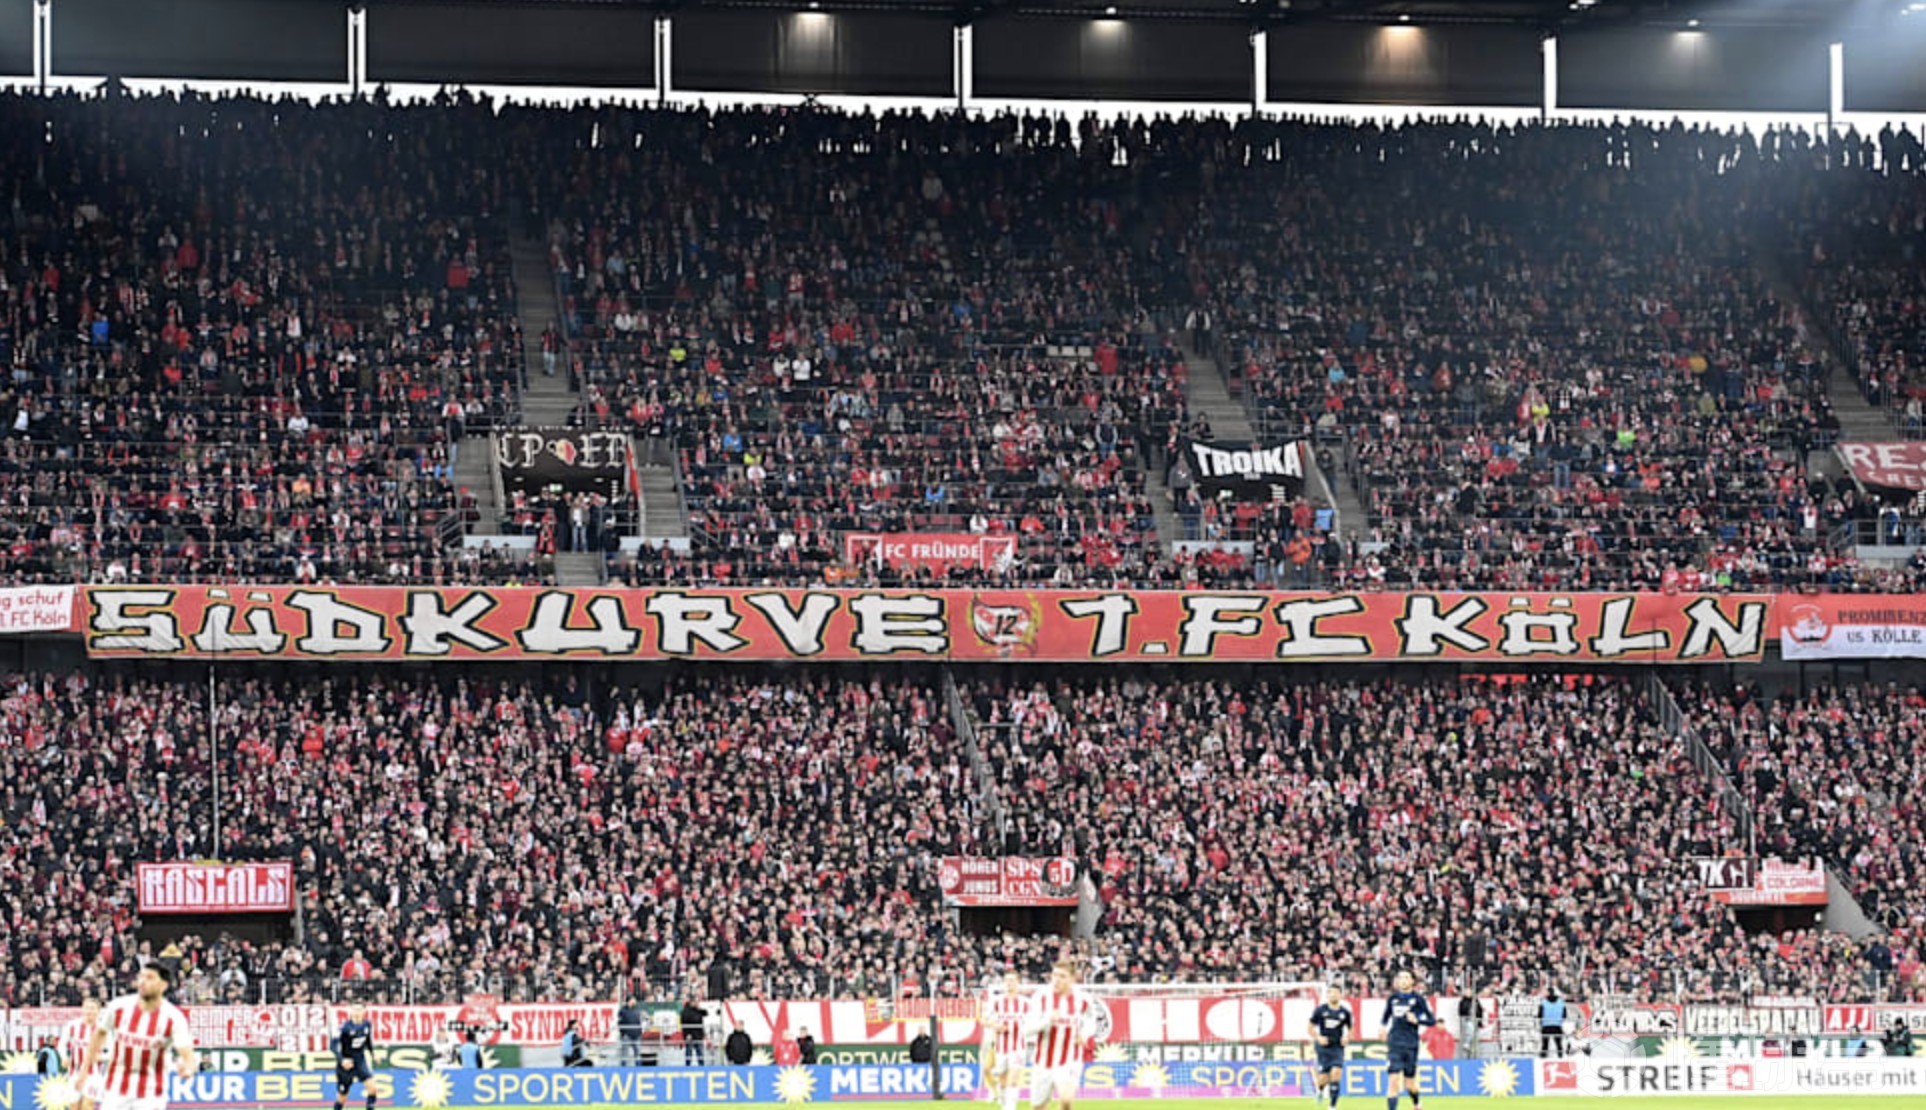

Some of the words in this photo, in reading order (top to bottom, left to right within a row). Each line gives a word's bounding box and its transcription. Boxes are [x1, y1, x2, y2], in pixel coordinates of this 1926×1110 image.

[1192, 441, 1303, 478] TROIKA
[885, 543, 907, 559] FC
[911, 541, 980, 560] FRÜNDE
[18, 590, 63, 606] schuf
[11, 611, 30, 627] FC
[33, 610, 67, 626] Köln
[86, 587, 950, 657] SÜDKURVE
[994, 614, 1018, 637] 12
[1392, 594, 1767, 661] KÖLN
[1872, 627, 1922, 644] KÖLLE
[144, 867, 286, 905] RASCALS
[511, 1008, 613, 1043] SYNDKAT
[1828, 1008, 1871, 1031] AJJ
[473, 1070, 755, 1104] SPORTWETTEN
[831, 1066, 976, 1095] MERKUR
[1597, 1065, 1719, 1092] STREIF
[1797, 1066, 1873, 1088] Häuser
[1881, 1067, 1918, 1088] mit
